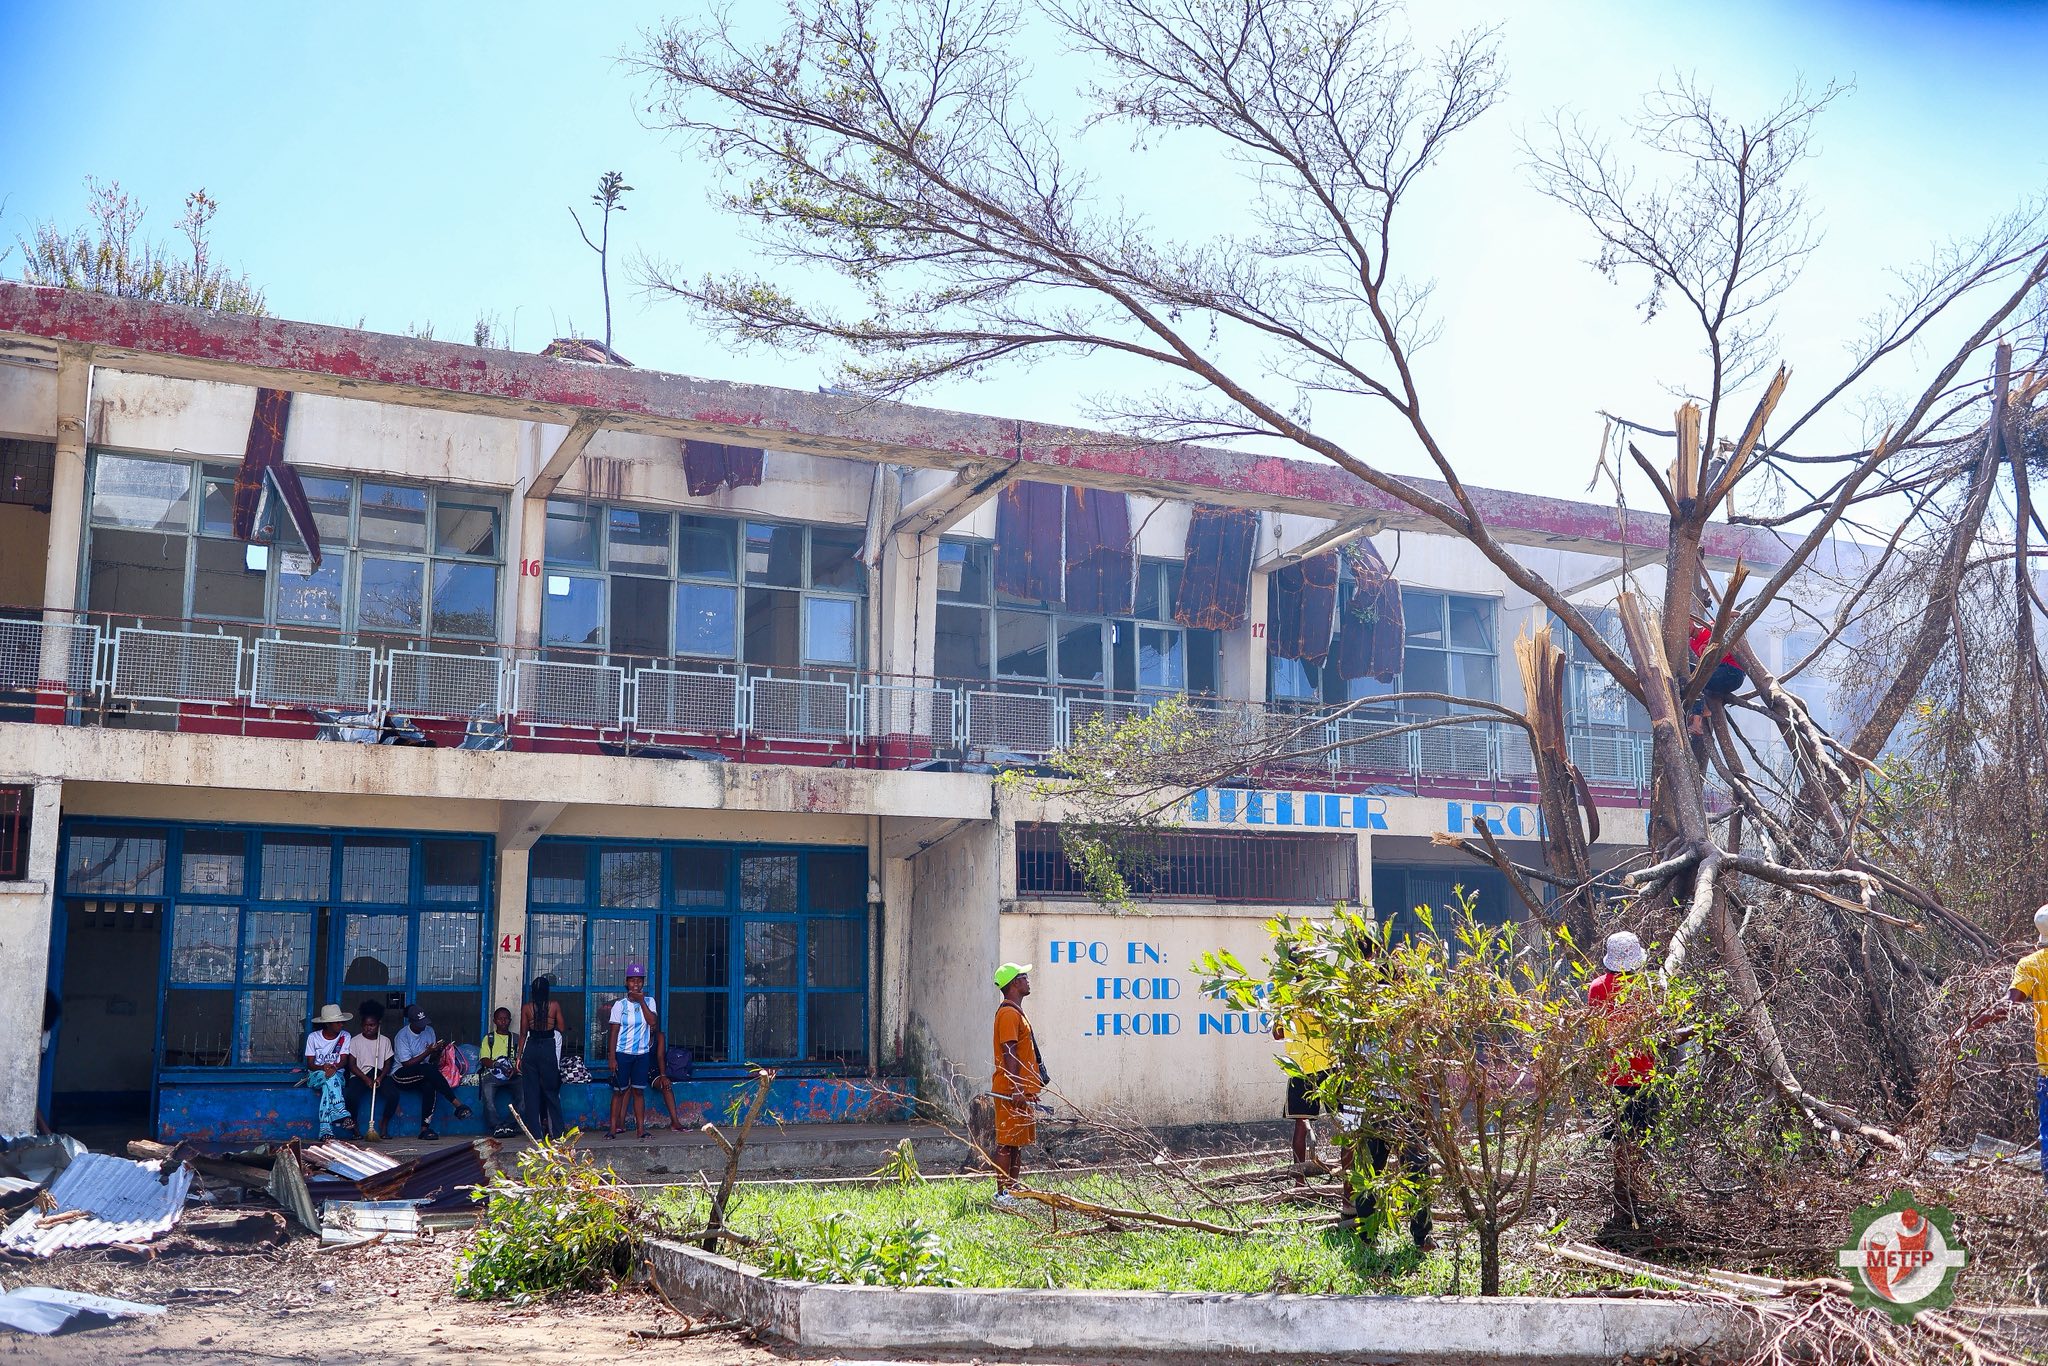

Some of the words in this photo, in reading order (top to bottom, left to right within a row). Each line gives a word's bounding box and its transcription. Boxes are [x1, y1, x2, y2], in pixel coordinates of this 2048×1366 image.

[521, 558, 540, 577] 16
[1252, 623, 1265, 638] 17
[499, 934, 522, 953] 41
[1050, 941, 1109, 966] FPQ
[1127, 942, 1168, 964] EN:
[1199, 1013, 1272, 1035] INDUS
